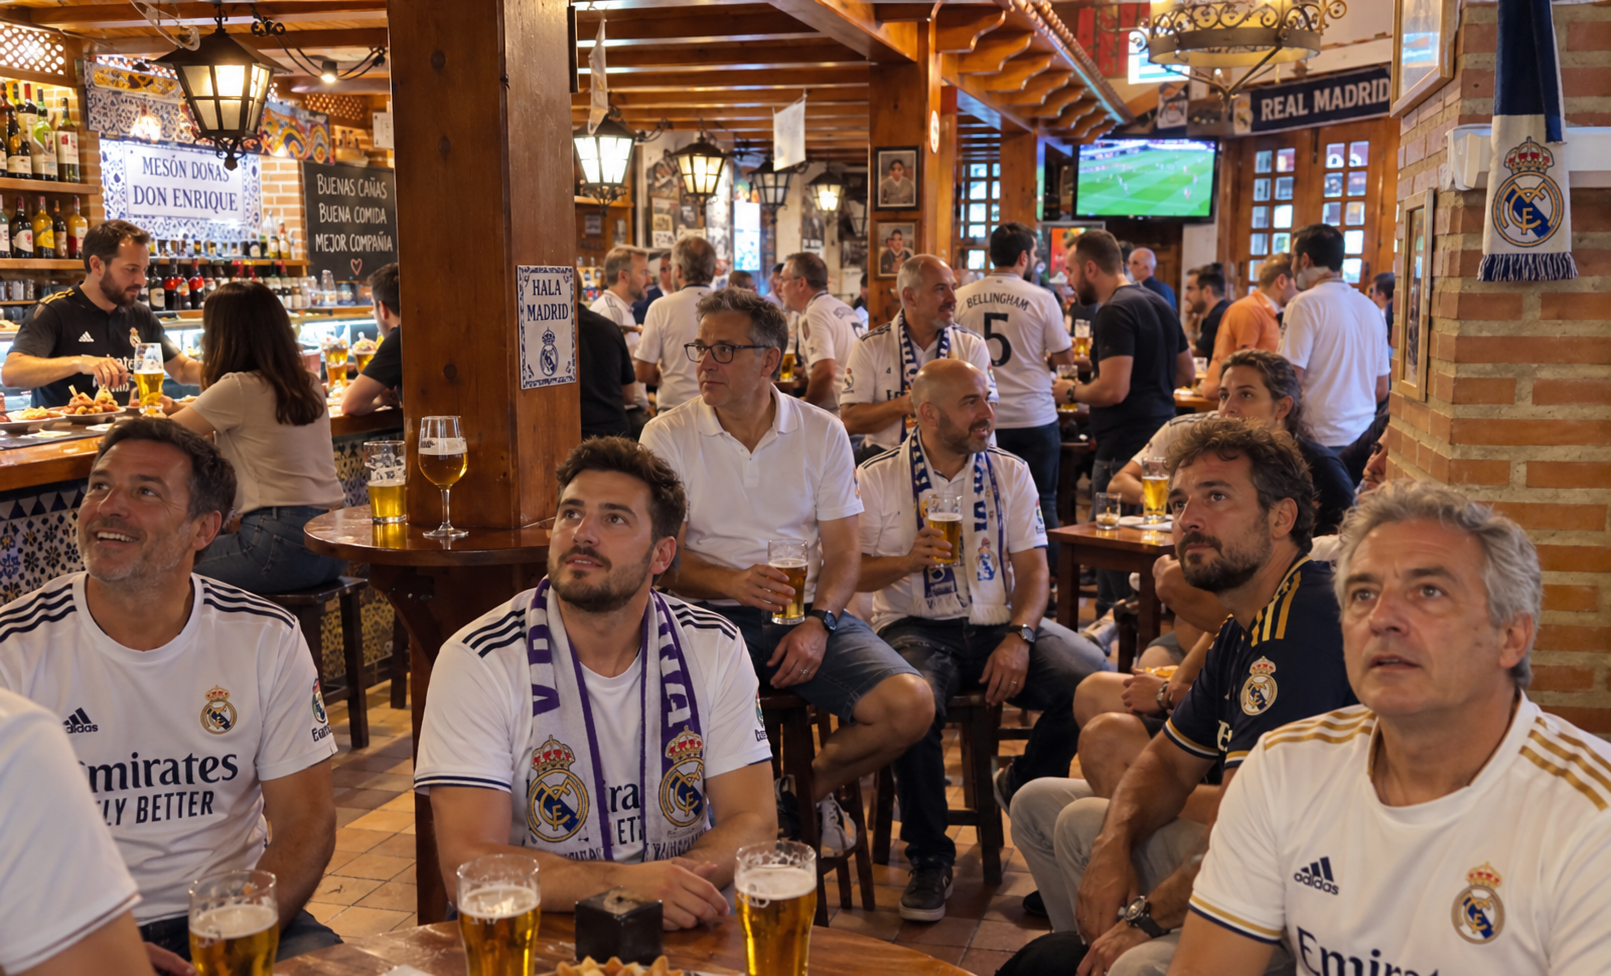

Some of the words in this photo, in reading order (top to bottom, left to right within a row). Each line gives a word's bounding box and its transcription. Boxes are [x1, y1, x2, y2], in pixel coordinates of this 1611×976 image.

[1261, 93, 1308, 121] REAL
[1313, 78, 1390, 113] MADRID
[142, 154, 187, 178] MESÓN
[316, 173, 356, 197] BUENAS
[357, 177, 387, 199] CAÑAS
[133, 185, 167, 207] DON
[172, 188, 238, 214] ENRIQUE
[318, 202, 351, 223] BUENA
[354, 206, 387, 224] COMIDA
[315, 233, 348, 253] MEJOR
[532, 279, 562, 296] HALA
[526, 303, 569, 321] MADRID
[966, 292, 1029, 311] BELLINGHAM
[984, 312, 1012, 367] 5
[66, 723, 98, 734] didas
[79, 751, 238, 793] mirates
[97, 797, 127, 826] LY
[135, 789, 214, 824] BETTER
[1293, 871, 1339, 896] adidas
